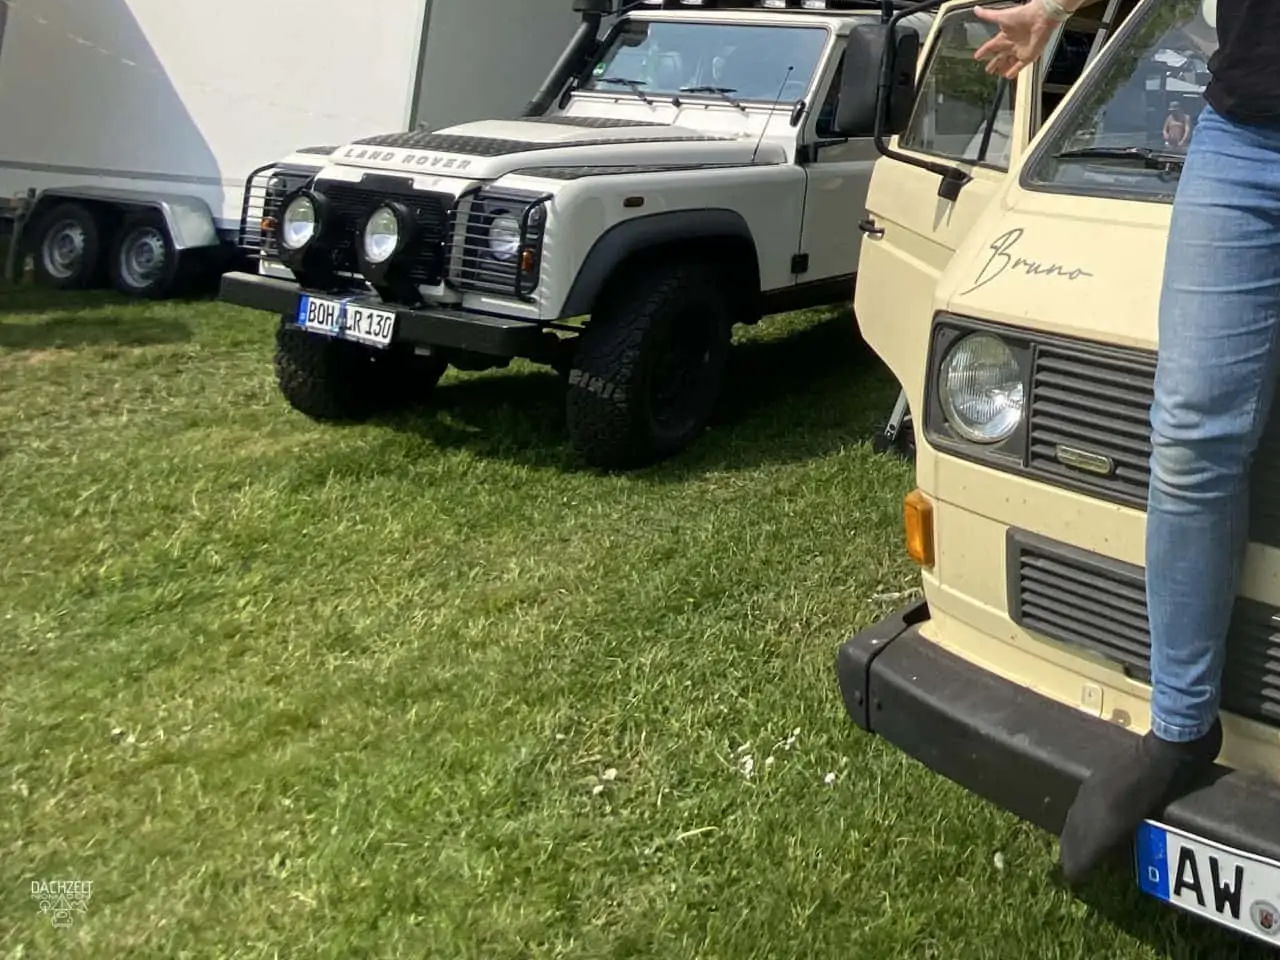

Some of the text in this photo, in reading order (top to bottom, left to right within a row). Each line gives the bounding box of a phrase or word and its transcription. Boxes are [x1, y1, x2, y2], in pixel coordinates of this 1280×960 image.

[343, 148, 472, 171] LAND ROVER
[959, 227, 1094, 296] Bruno
[308, 301, 335, 327] BOH
[364, 312, 393, 339] 130
[1173, 845, 1244, 920] AW
